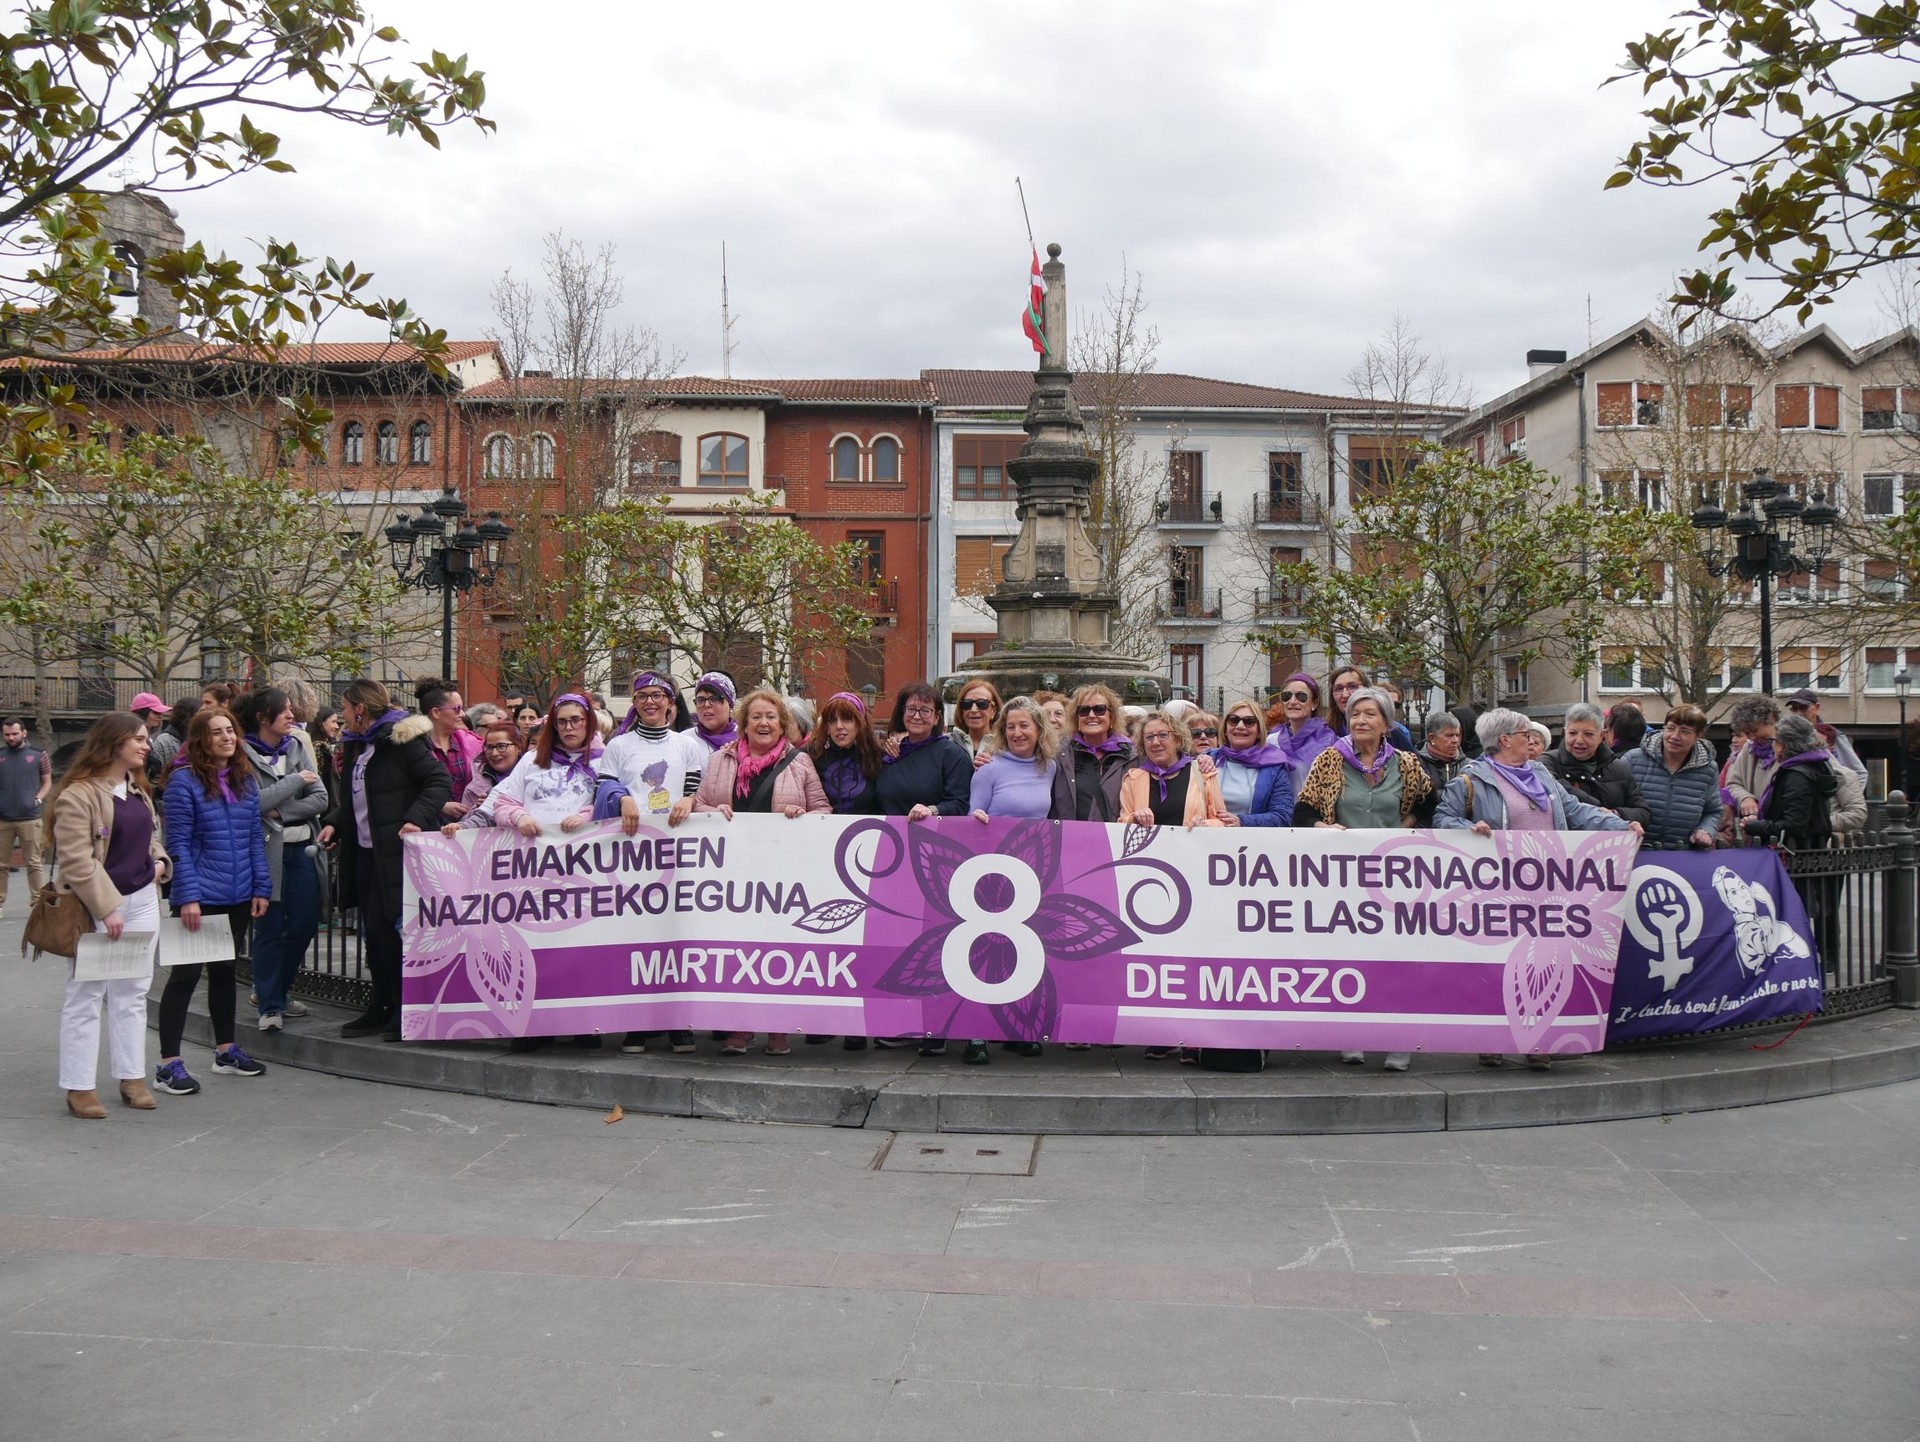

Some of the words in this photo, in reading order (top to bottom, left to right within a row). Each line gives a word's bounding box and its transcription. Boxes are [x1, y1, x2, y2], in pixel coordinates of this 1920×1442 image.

[490, 836, 726, 882] EMAKUMEEN
[1207, 846, 1278, 887] DÍA
[1289, 853, 1627, 892] INTERNACIONAL
[418, 882, 669, 928] NAZIOARTEKO
[673, 880, 811, 915] EGUNA
[1237, 899, 1293, 933] DE
[1304, 900, 1384, 934] LAS
[1394, 902, 1592, 938] MUJERES
[941, 853, 1046, 1005] 8
[630, 948, 857, 987] MARTXOAK
[1126, 962, 1187, 1000] DE
[1199, 967, 1367, 1004] MARZO
[1684, 997, 1717, 1014] será
[1781, 981, 1790, 992] o
[1791, 978, 1807, 991] no
